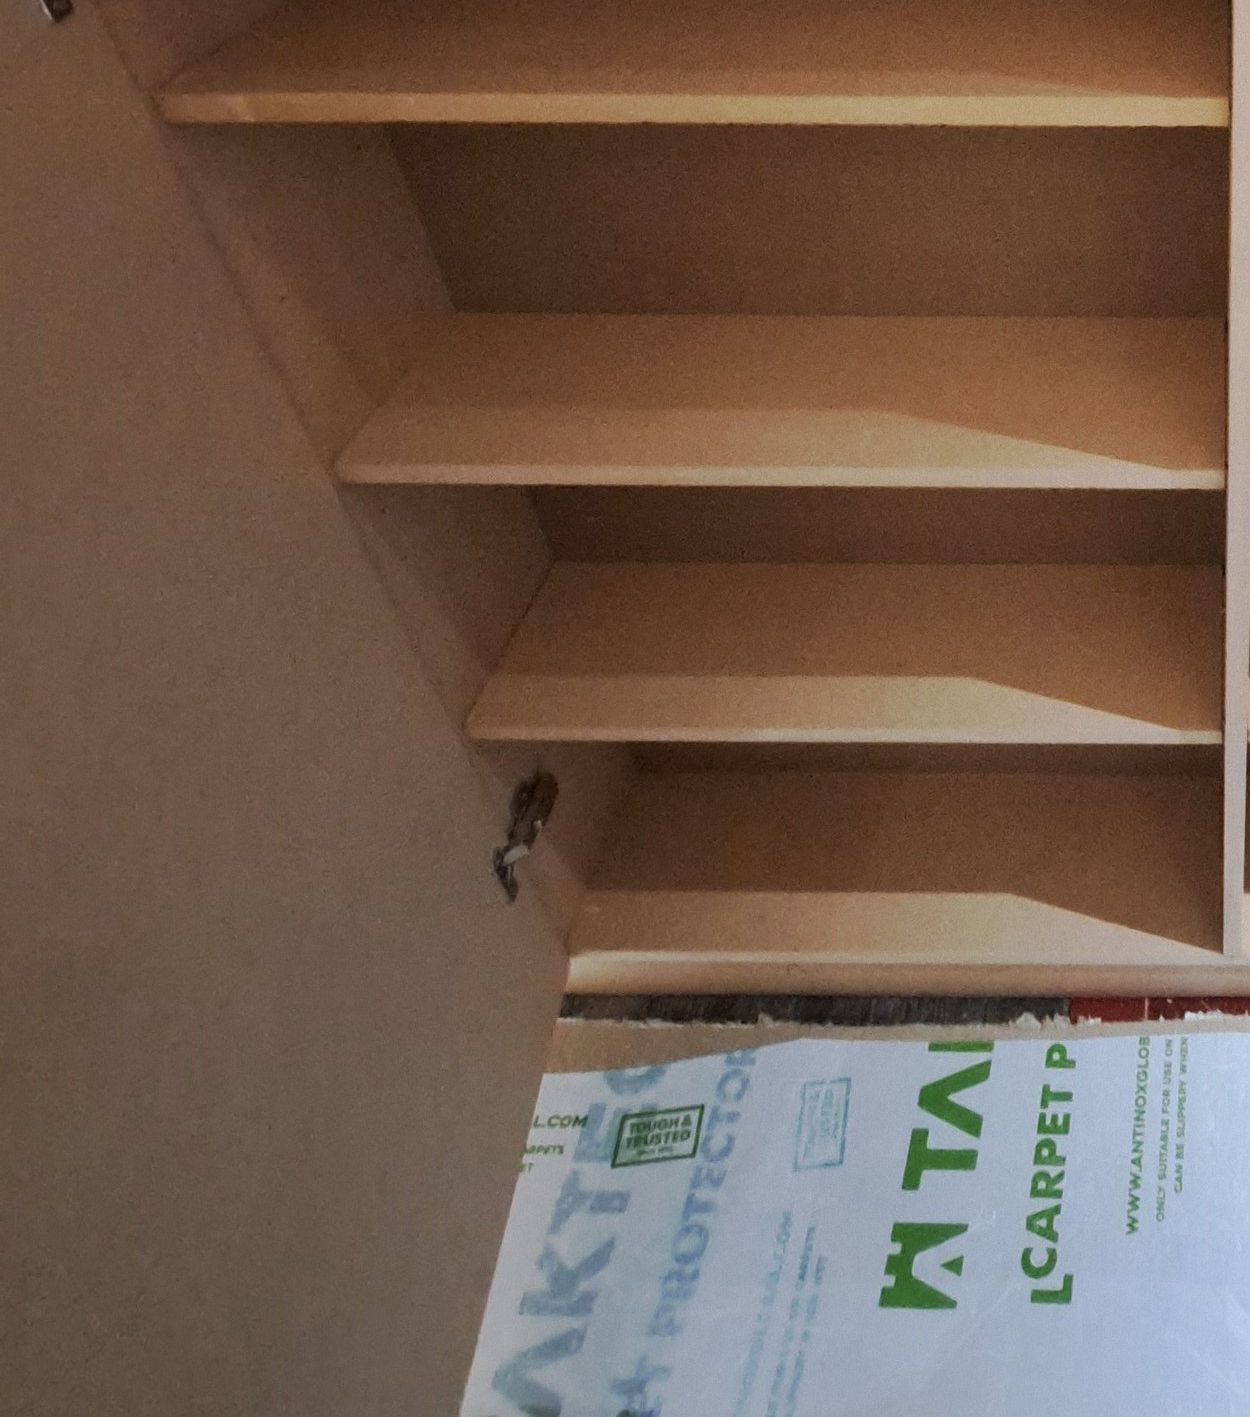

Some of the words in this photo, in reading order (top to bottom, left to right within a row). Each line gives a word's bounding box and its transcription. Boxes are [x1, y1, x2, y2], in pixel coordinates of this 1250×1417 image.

[1165, 1038, 1174, 1058] ON
[1162, 1061, 1173, 1086] USE
[902, 1040, 995, 1191] TA
[1161, 1089, 1171, 1115] FOR
[1176, 1080, 1187, 1139] SLIPPERY
[626, 1129, 692, 1150] TRUSTED
[1158, 1118, 1170, 1182] SUITABLE
[1174, 1164, 1184, 1194] CAN
[1156, 1185, 1167, 1223] ONLY
